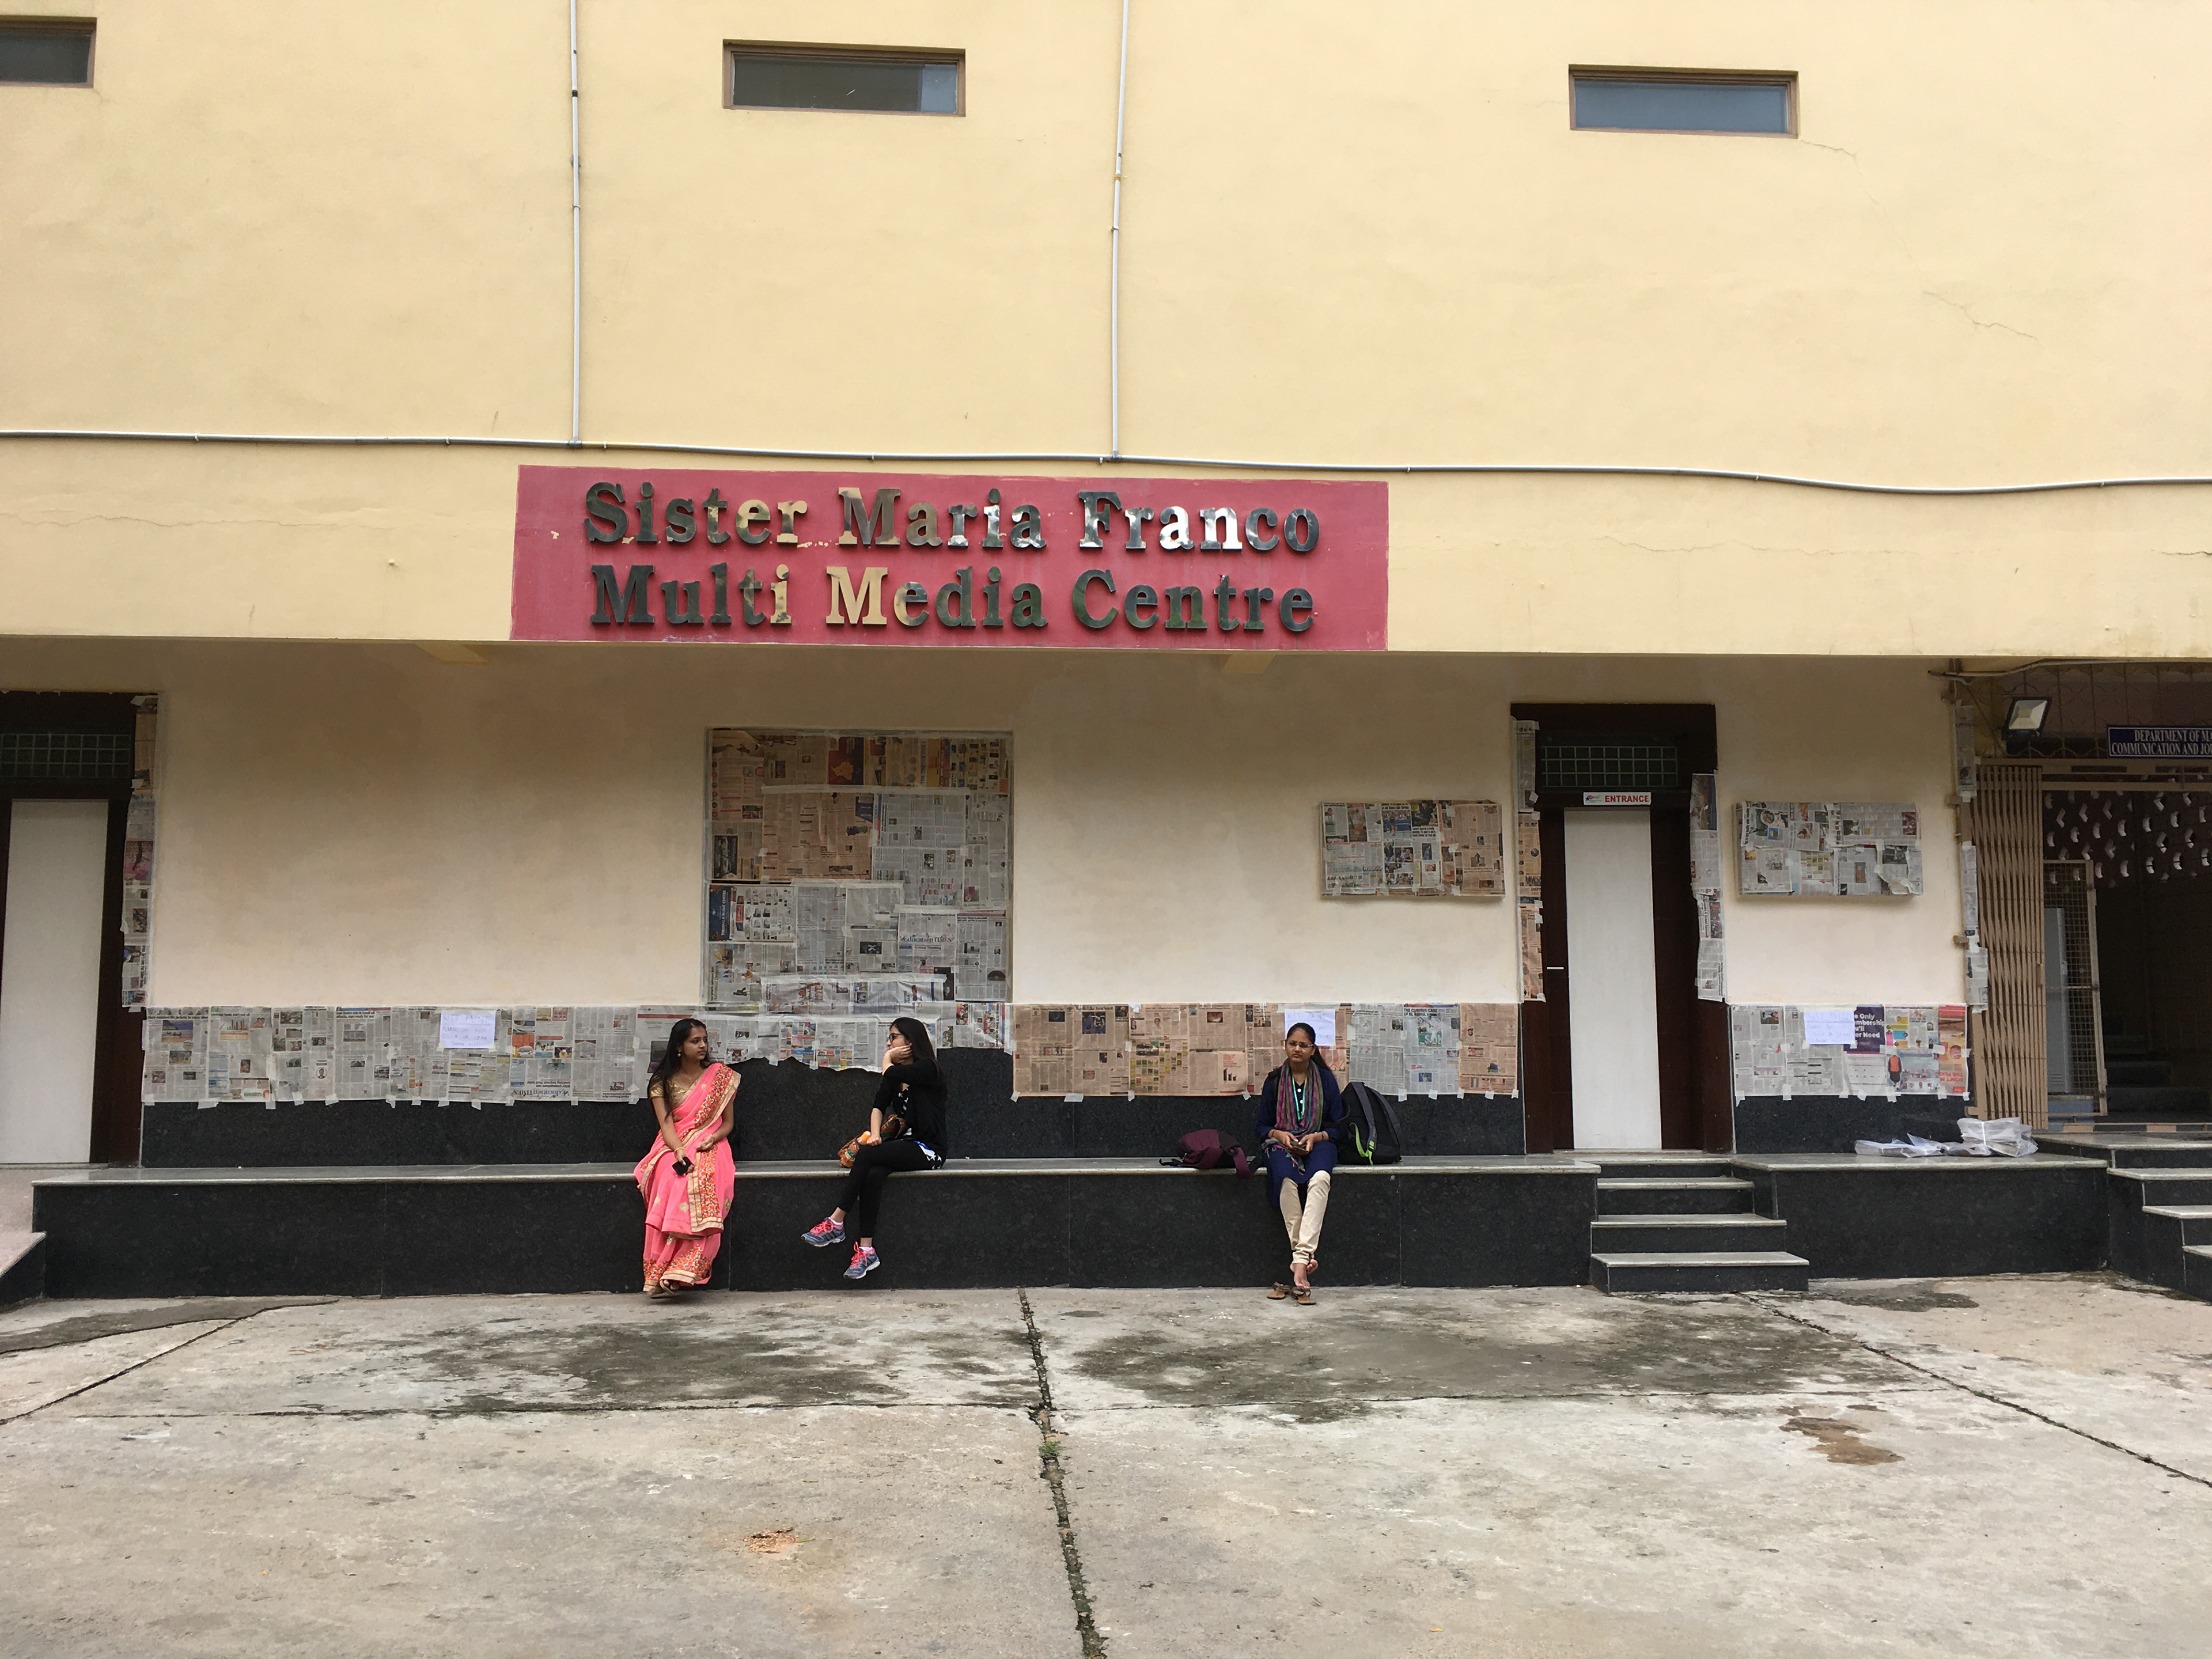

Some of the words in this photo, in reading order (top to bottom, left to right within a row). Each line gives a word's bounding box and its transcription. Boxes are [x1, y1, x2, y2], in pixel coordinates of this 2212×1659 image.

[584, 481, 808, 544] Sister
[838, 487, 1047, 548] Maria
[1079, 490, 1320, 552] Franco
[590, 562, 793, 626] Multi
[825, 565, 1048, 627] Media
[1072, 569, 1314, 632] Centre
[2135, 730, 2188, 742] DEPARTMENT
[2189, 730, 2200, 742] OF
[2111, 743, 2181, 755] COMMUNICATION
[2181, 743, 2199, 755] AND
[444, 1014, 460, 1022] WET
[465, 1014, 490, 1023] PAINT
